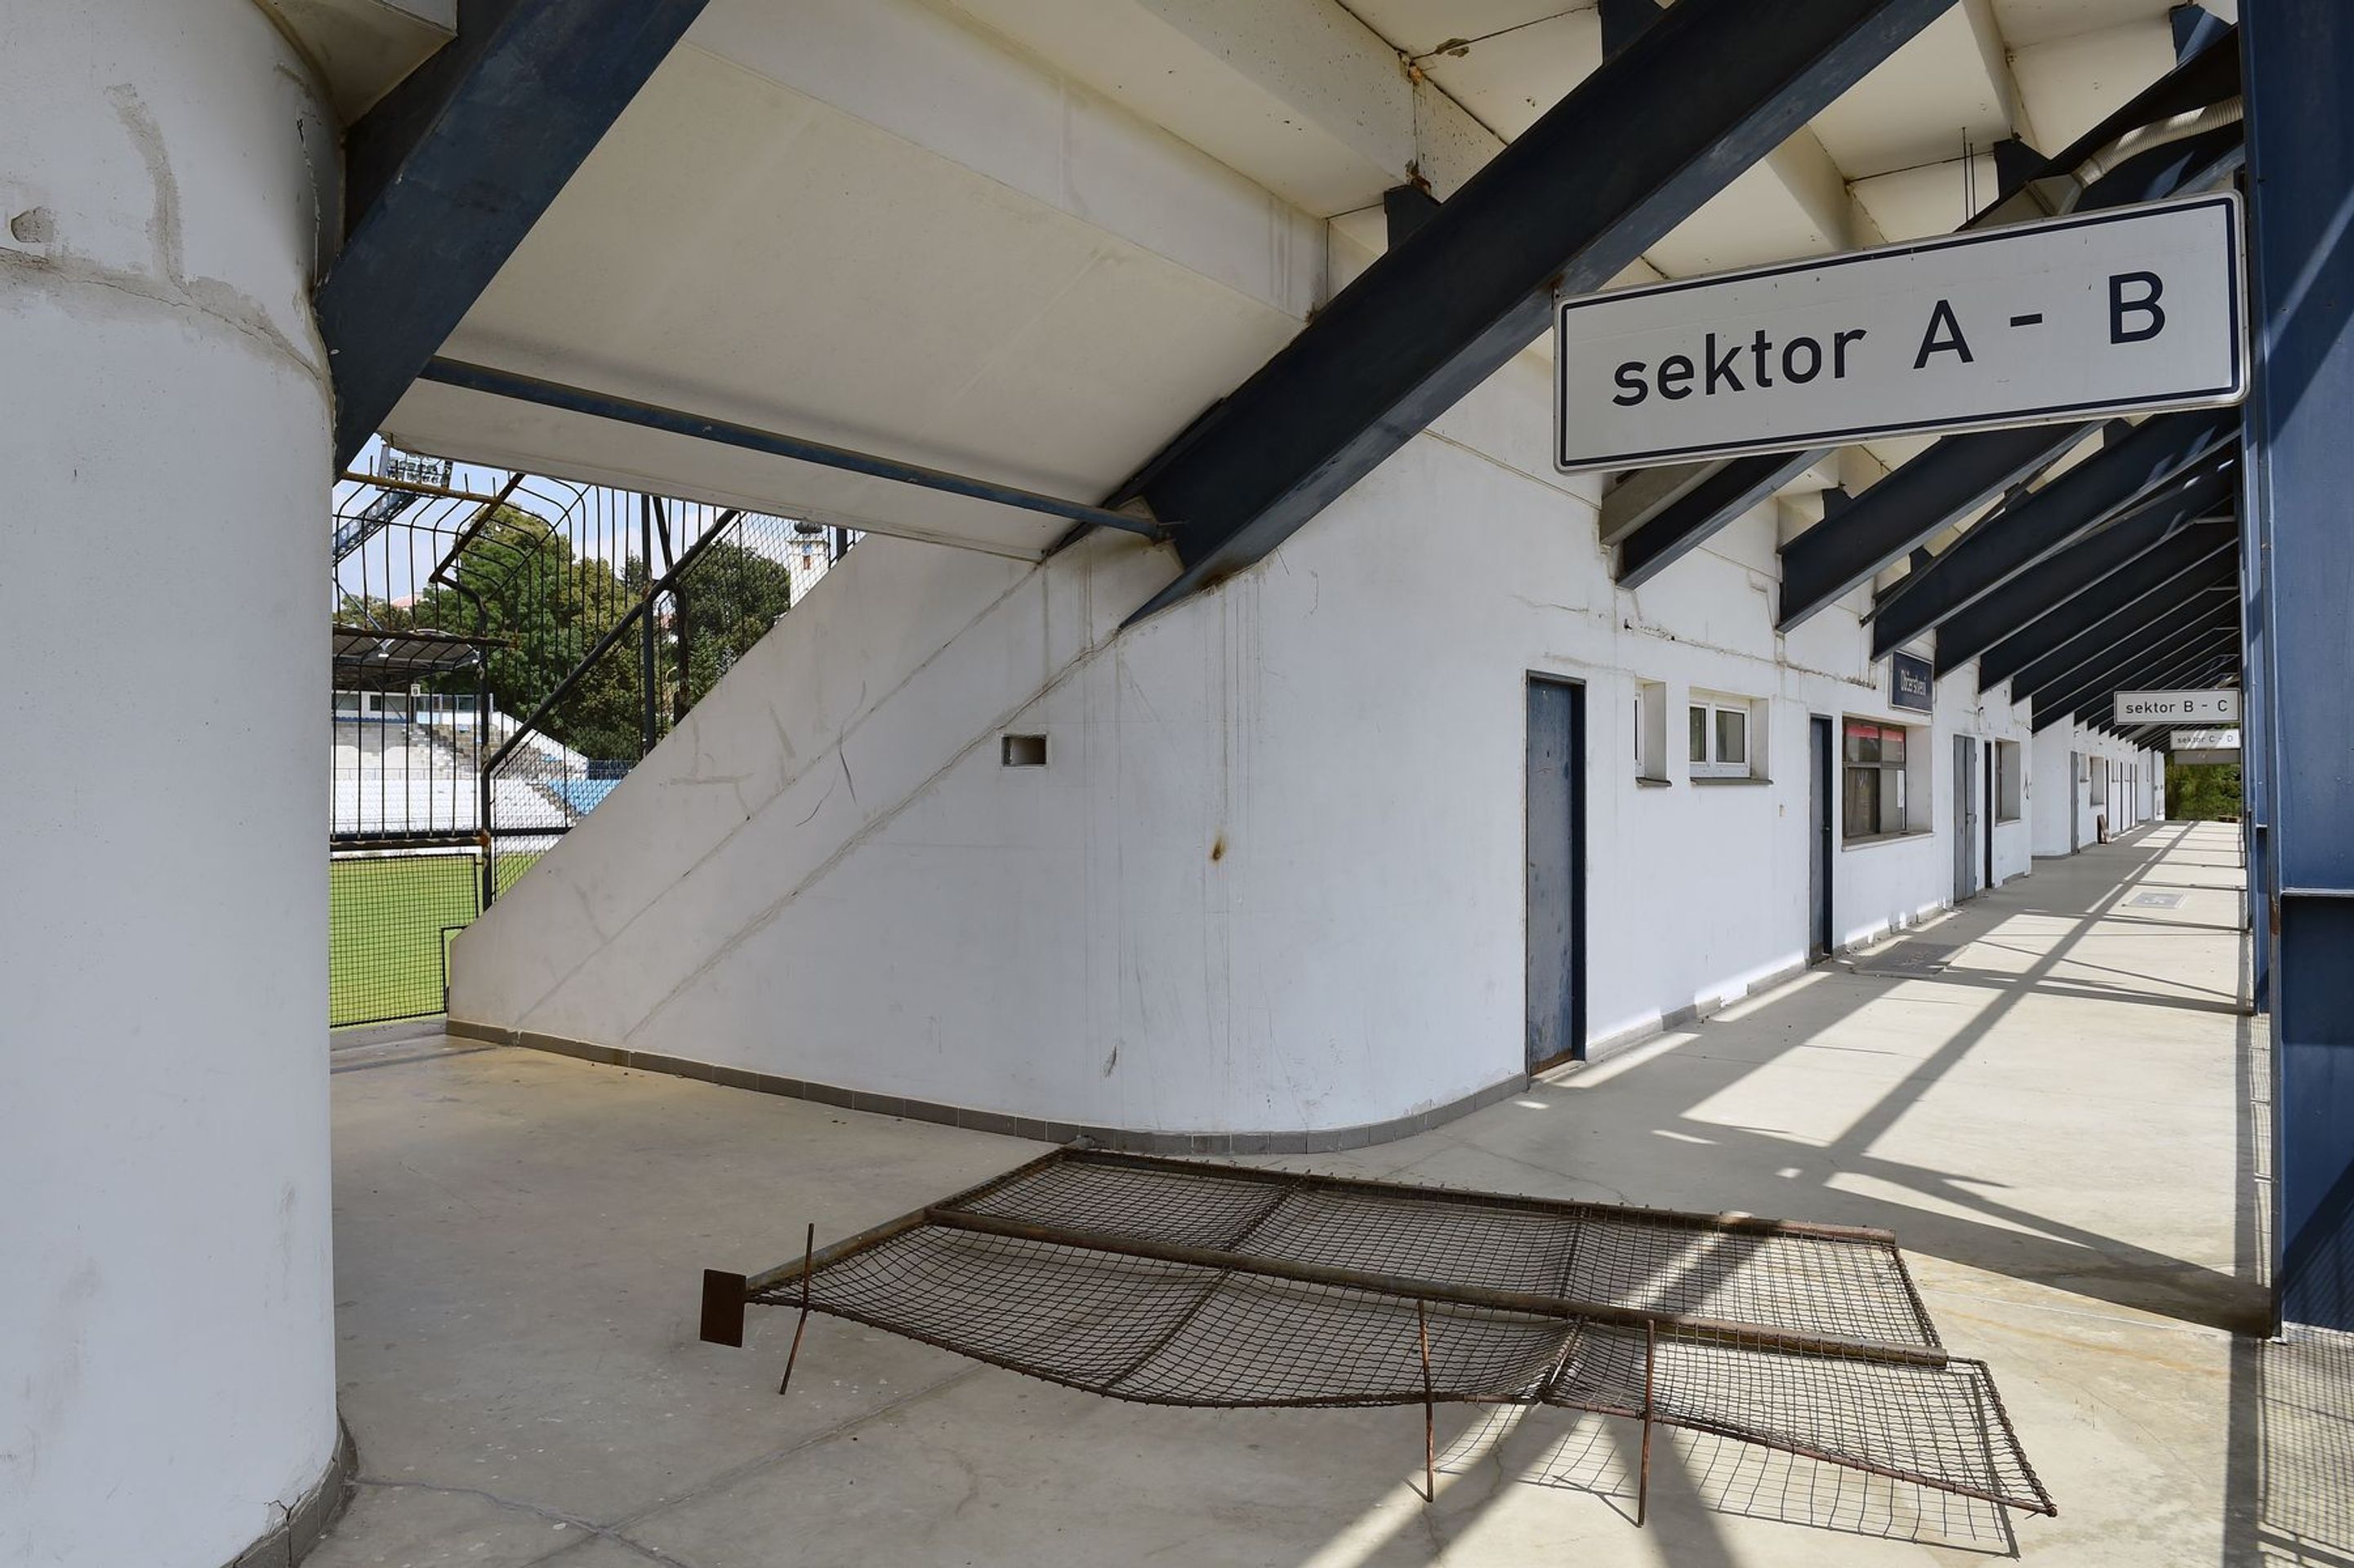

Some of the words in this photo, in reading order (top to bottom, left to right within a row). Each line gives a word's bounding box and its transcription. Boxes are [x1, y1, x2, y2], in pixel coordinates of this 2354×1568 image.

[1612, 327, 1867, 408] sektor
[1913, 298, 1975, 370] A
[2009, 312, 2044, 327] -
[2108, 270, 2167, 345] B
[2126, 702, 2175, 714] sektor
[2184, 701, 2194, 712] B
[2218, 700, 2228, 712] C
